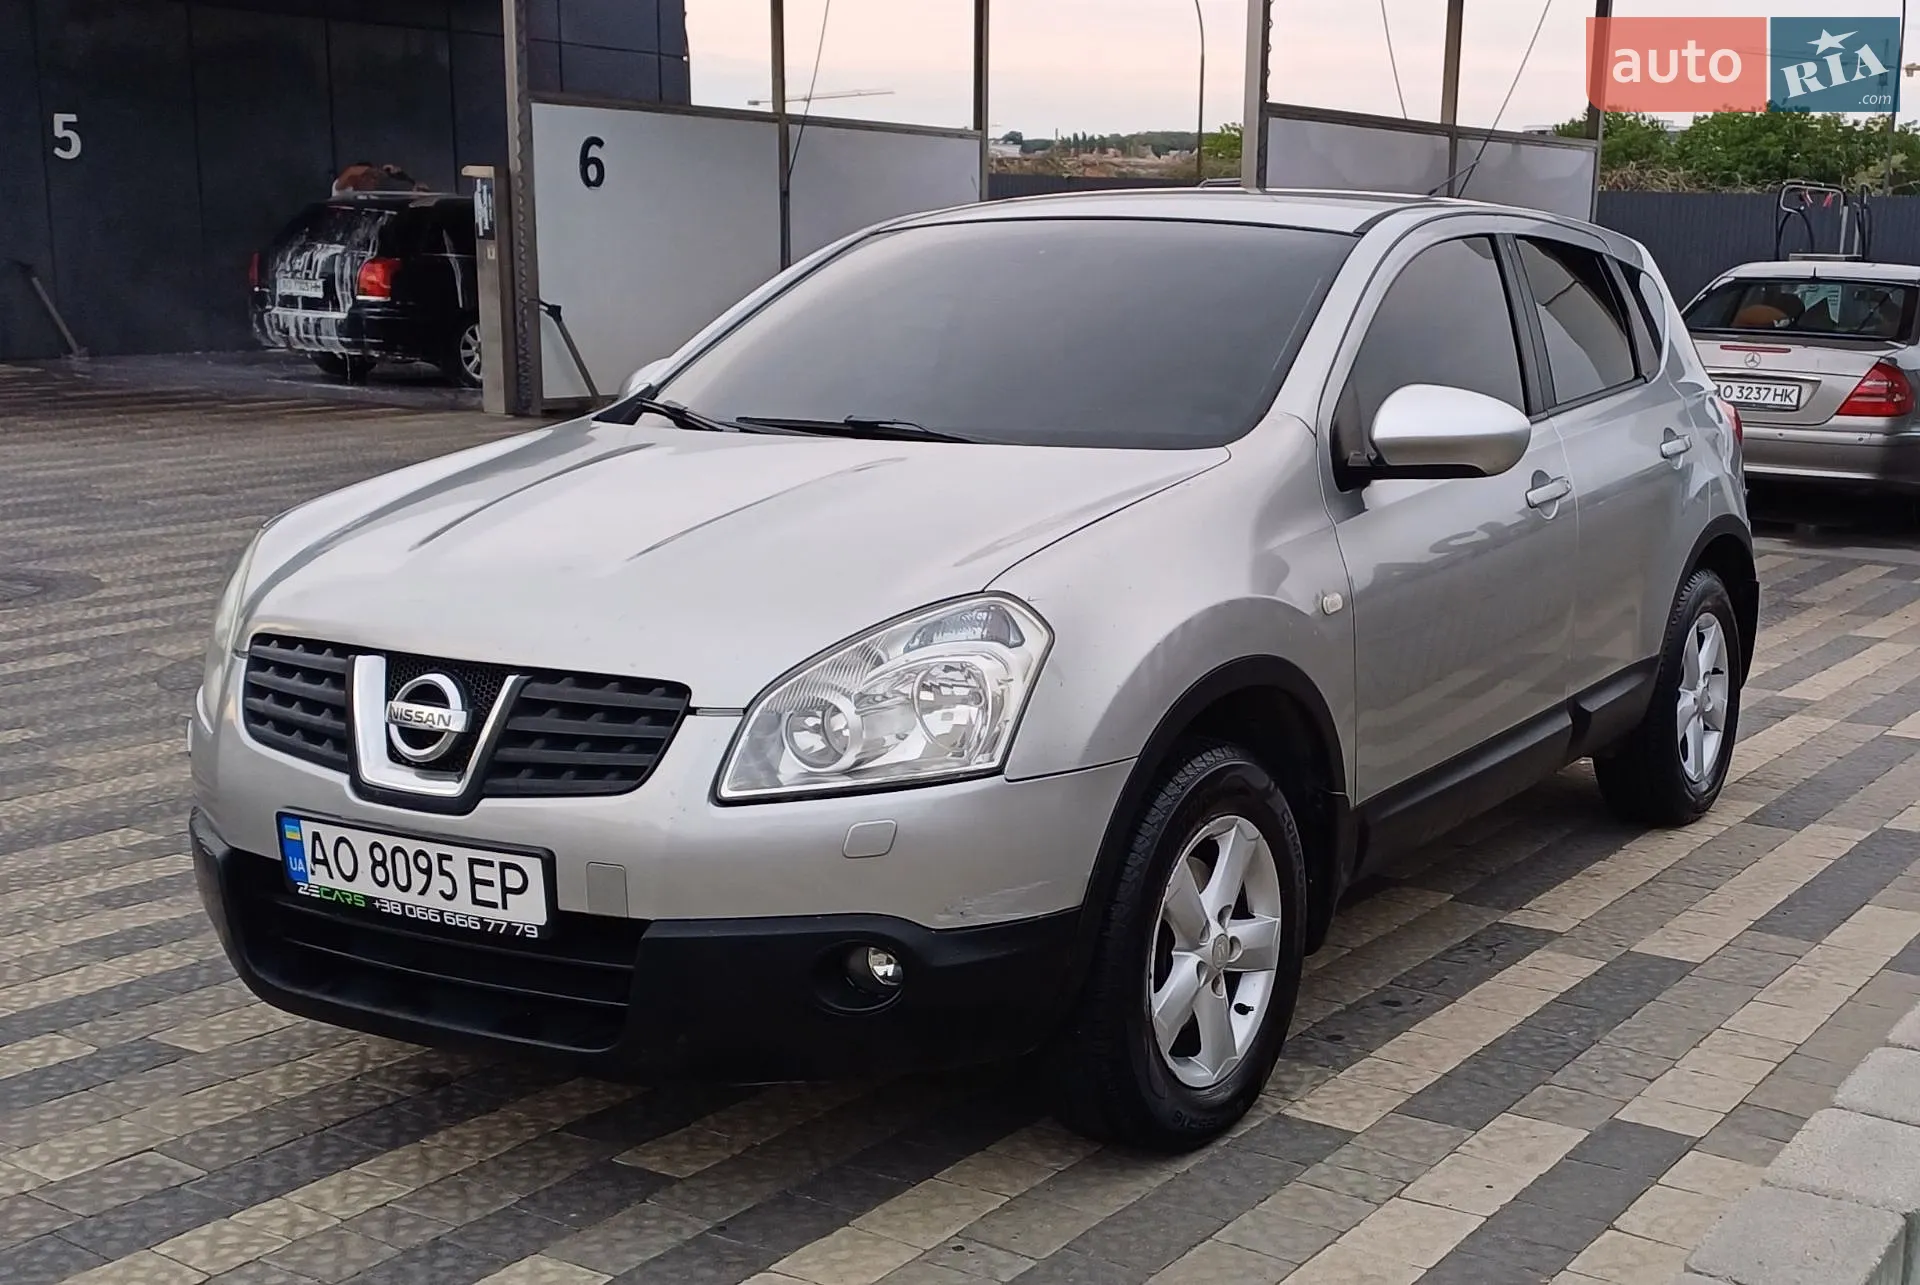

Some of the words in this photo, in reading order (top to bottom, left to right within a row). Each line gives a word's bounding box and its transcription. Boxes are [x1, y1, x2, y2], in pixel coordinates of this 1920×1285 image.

[54, 113, 82, 159] 5
[580, 136, 606, 188] 6
[1735, 386, 1772, 401] 3237
[1773, 389, 1794, 403] HK
[389, 703, 452, 726] NISSAN
[290, 857, 306, 873] UA
[310, 831, 358, 882] AO
[369, 841, 458, 901] 8095
[468, 857, 529, 910] EP
[372, 898, 402, 916] +38
[405, 904, 441, 923] 066
[443, 911, 481, 930] 666
